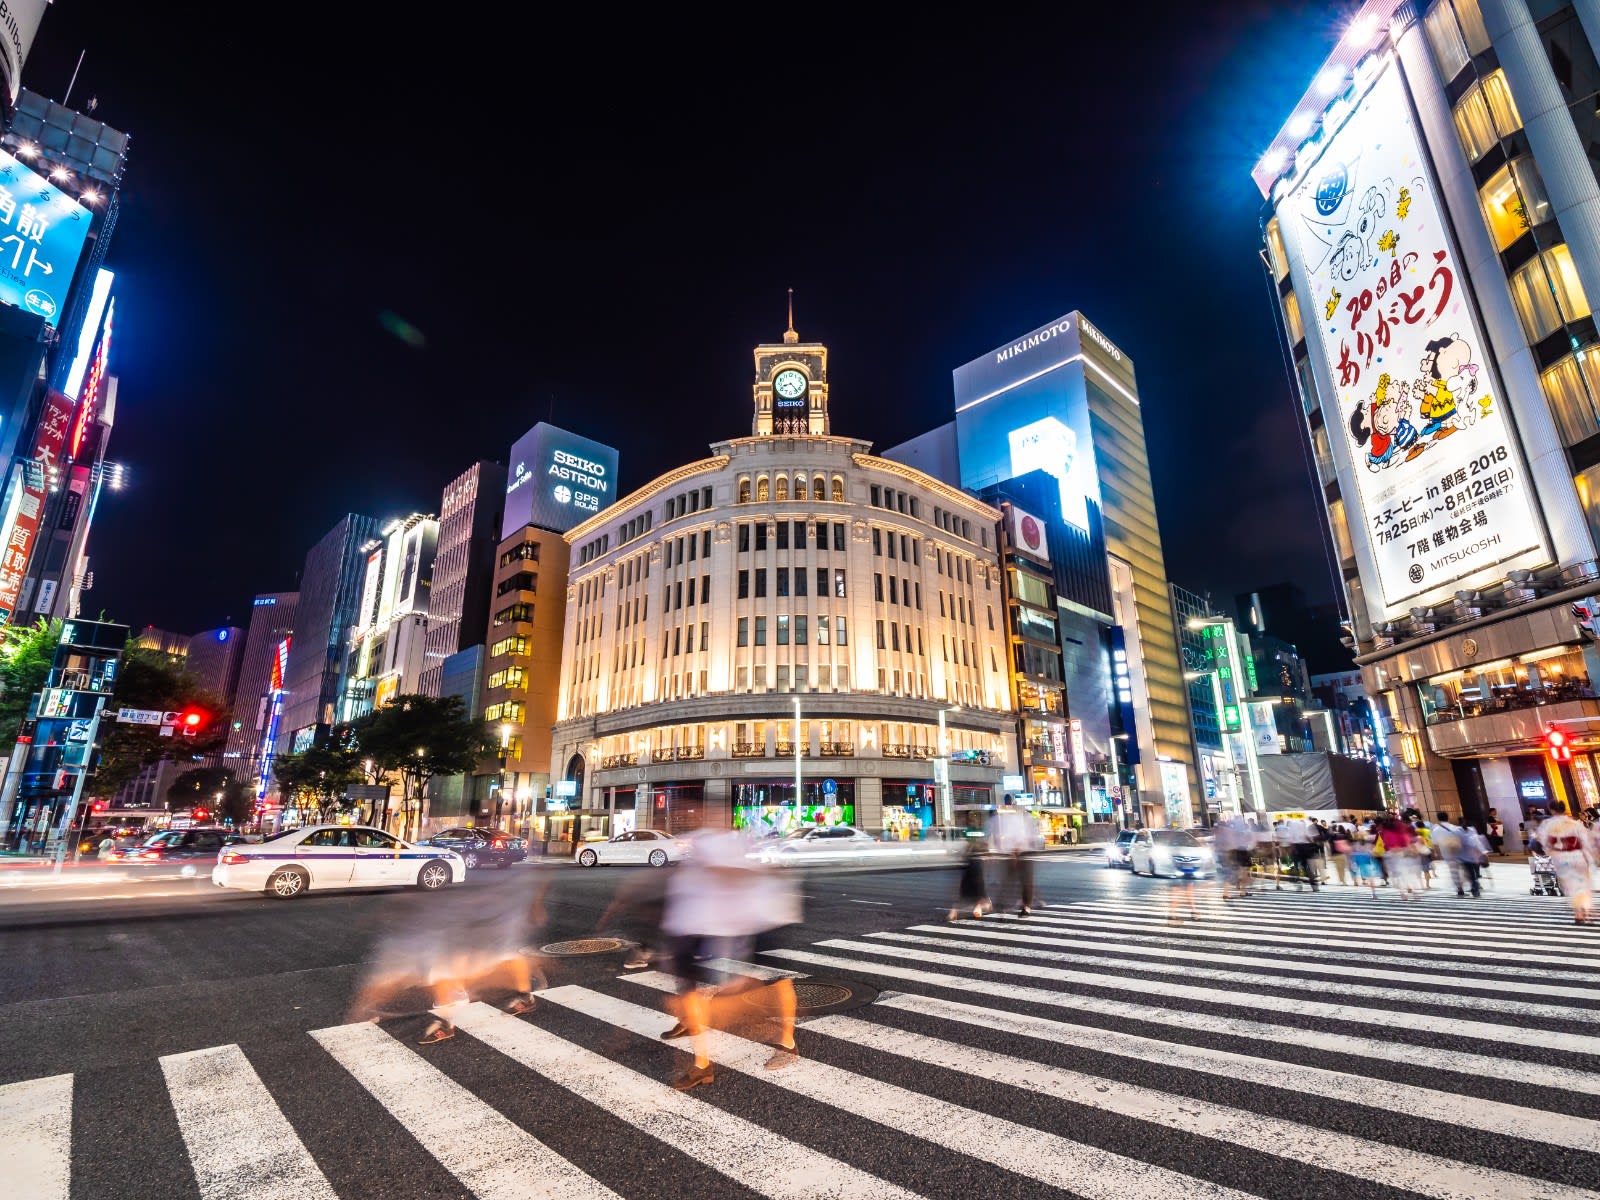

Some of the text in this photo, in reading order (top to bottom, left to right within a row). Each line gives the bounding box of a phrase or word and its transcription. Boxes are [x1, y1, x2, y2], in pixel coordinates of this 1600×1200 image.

[1346, 252, 1419, 331] 20回目の
[1082, 319, 1121, 361] MIKIMOTO
[1336, 250, 1453, 387] ありがとう
[996, 320, 1070, 364] MIKIMOTO
[548, 464, 607, 492] ASTRON
[553, 450, 605, 476] SEIKO
[574, 491, 599, 506] GPS
[574, 500, 599, 511] SOLAR
[1373, 494, 1424, 529] スヌーピー
[1426, 485, 1440, 500] in
[1441, 468, 1468, 493] 銀座
[1469, 445, 1508, 476] 2018
[1406, 511, 1488, 559] 7階 催物会場
[1430, 533, 1502, 571] MITSUKOSHI
[1213, 626, 1232, 679] 教文館
